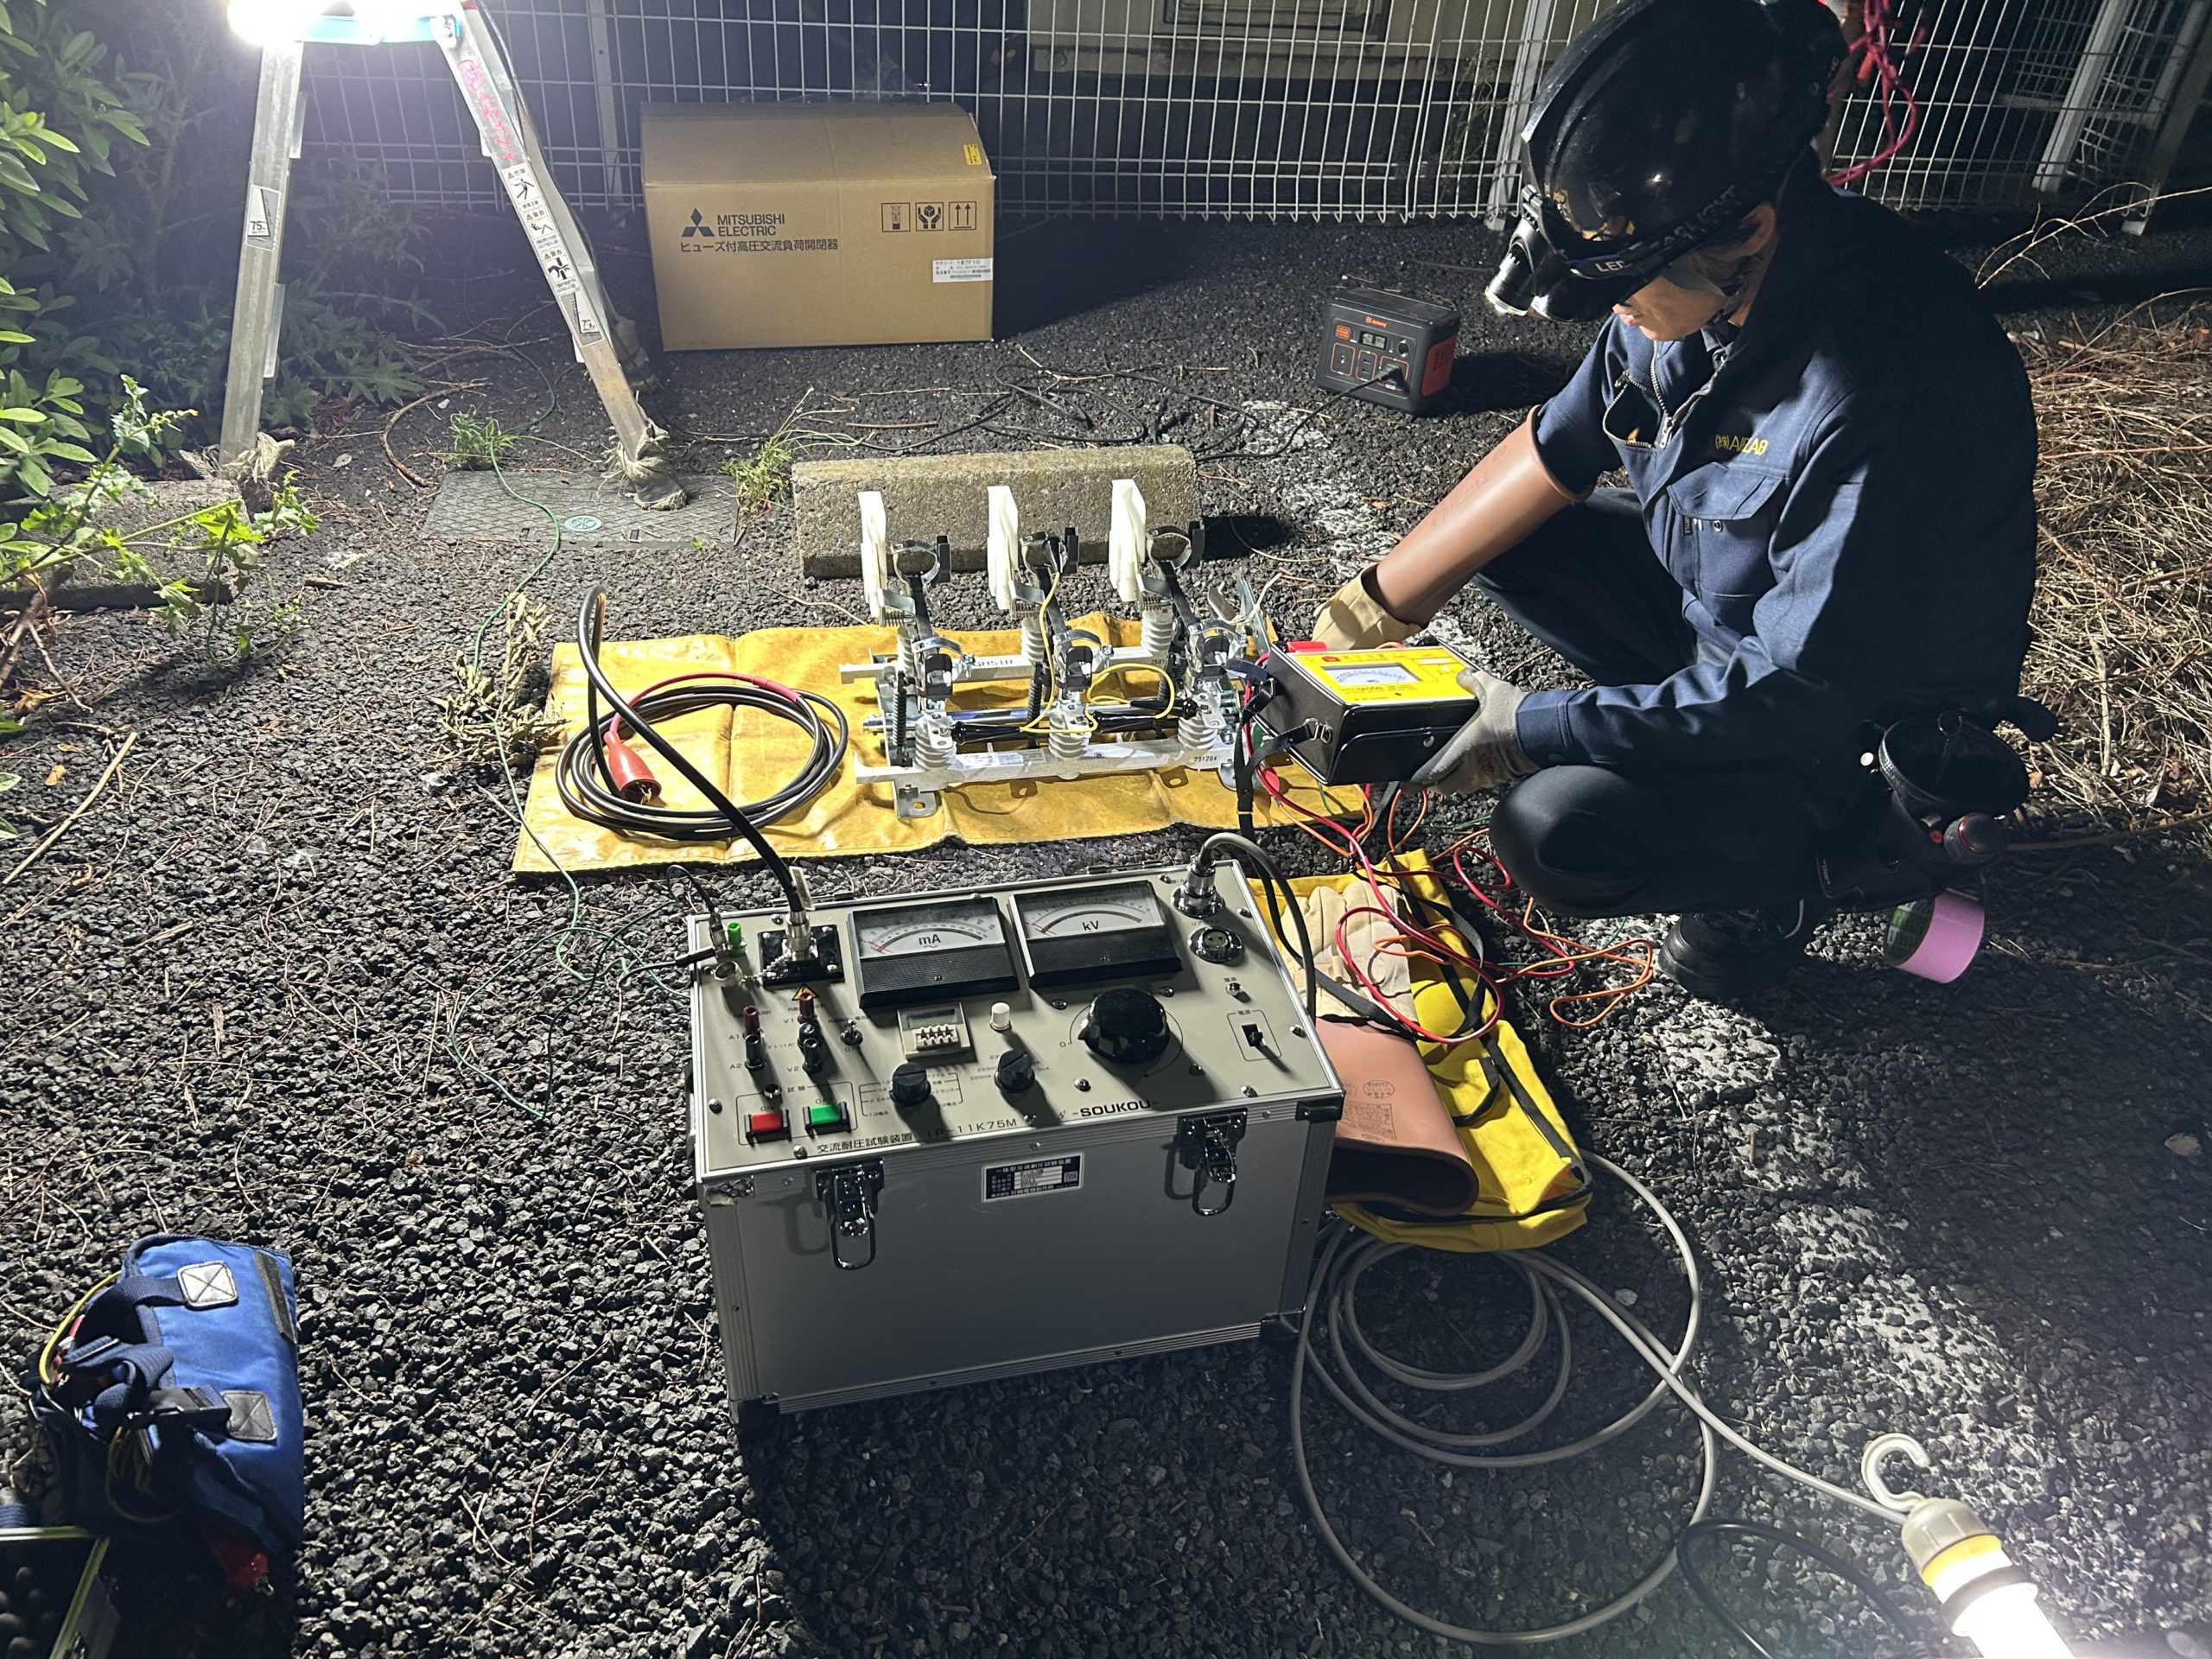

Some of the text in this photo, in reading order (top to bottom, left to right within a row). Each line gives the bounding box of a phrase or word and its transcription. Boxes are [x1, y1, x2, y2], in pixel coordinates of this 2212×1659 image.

[717, 213, 785, 226] MITSUBISHI
[718, 226, 777, 237] ELECTRIC
[680, 238, 839, 253] ヒューズ付高圧交流負荷開閉器
[1082, 920, 1099, 931] kV
[918, 934, 941, 945] mA
[817, 1133, 914, 1154] 交流耐圧試験装置
